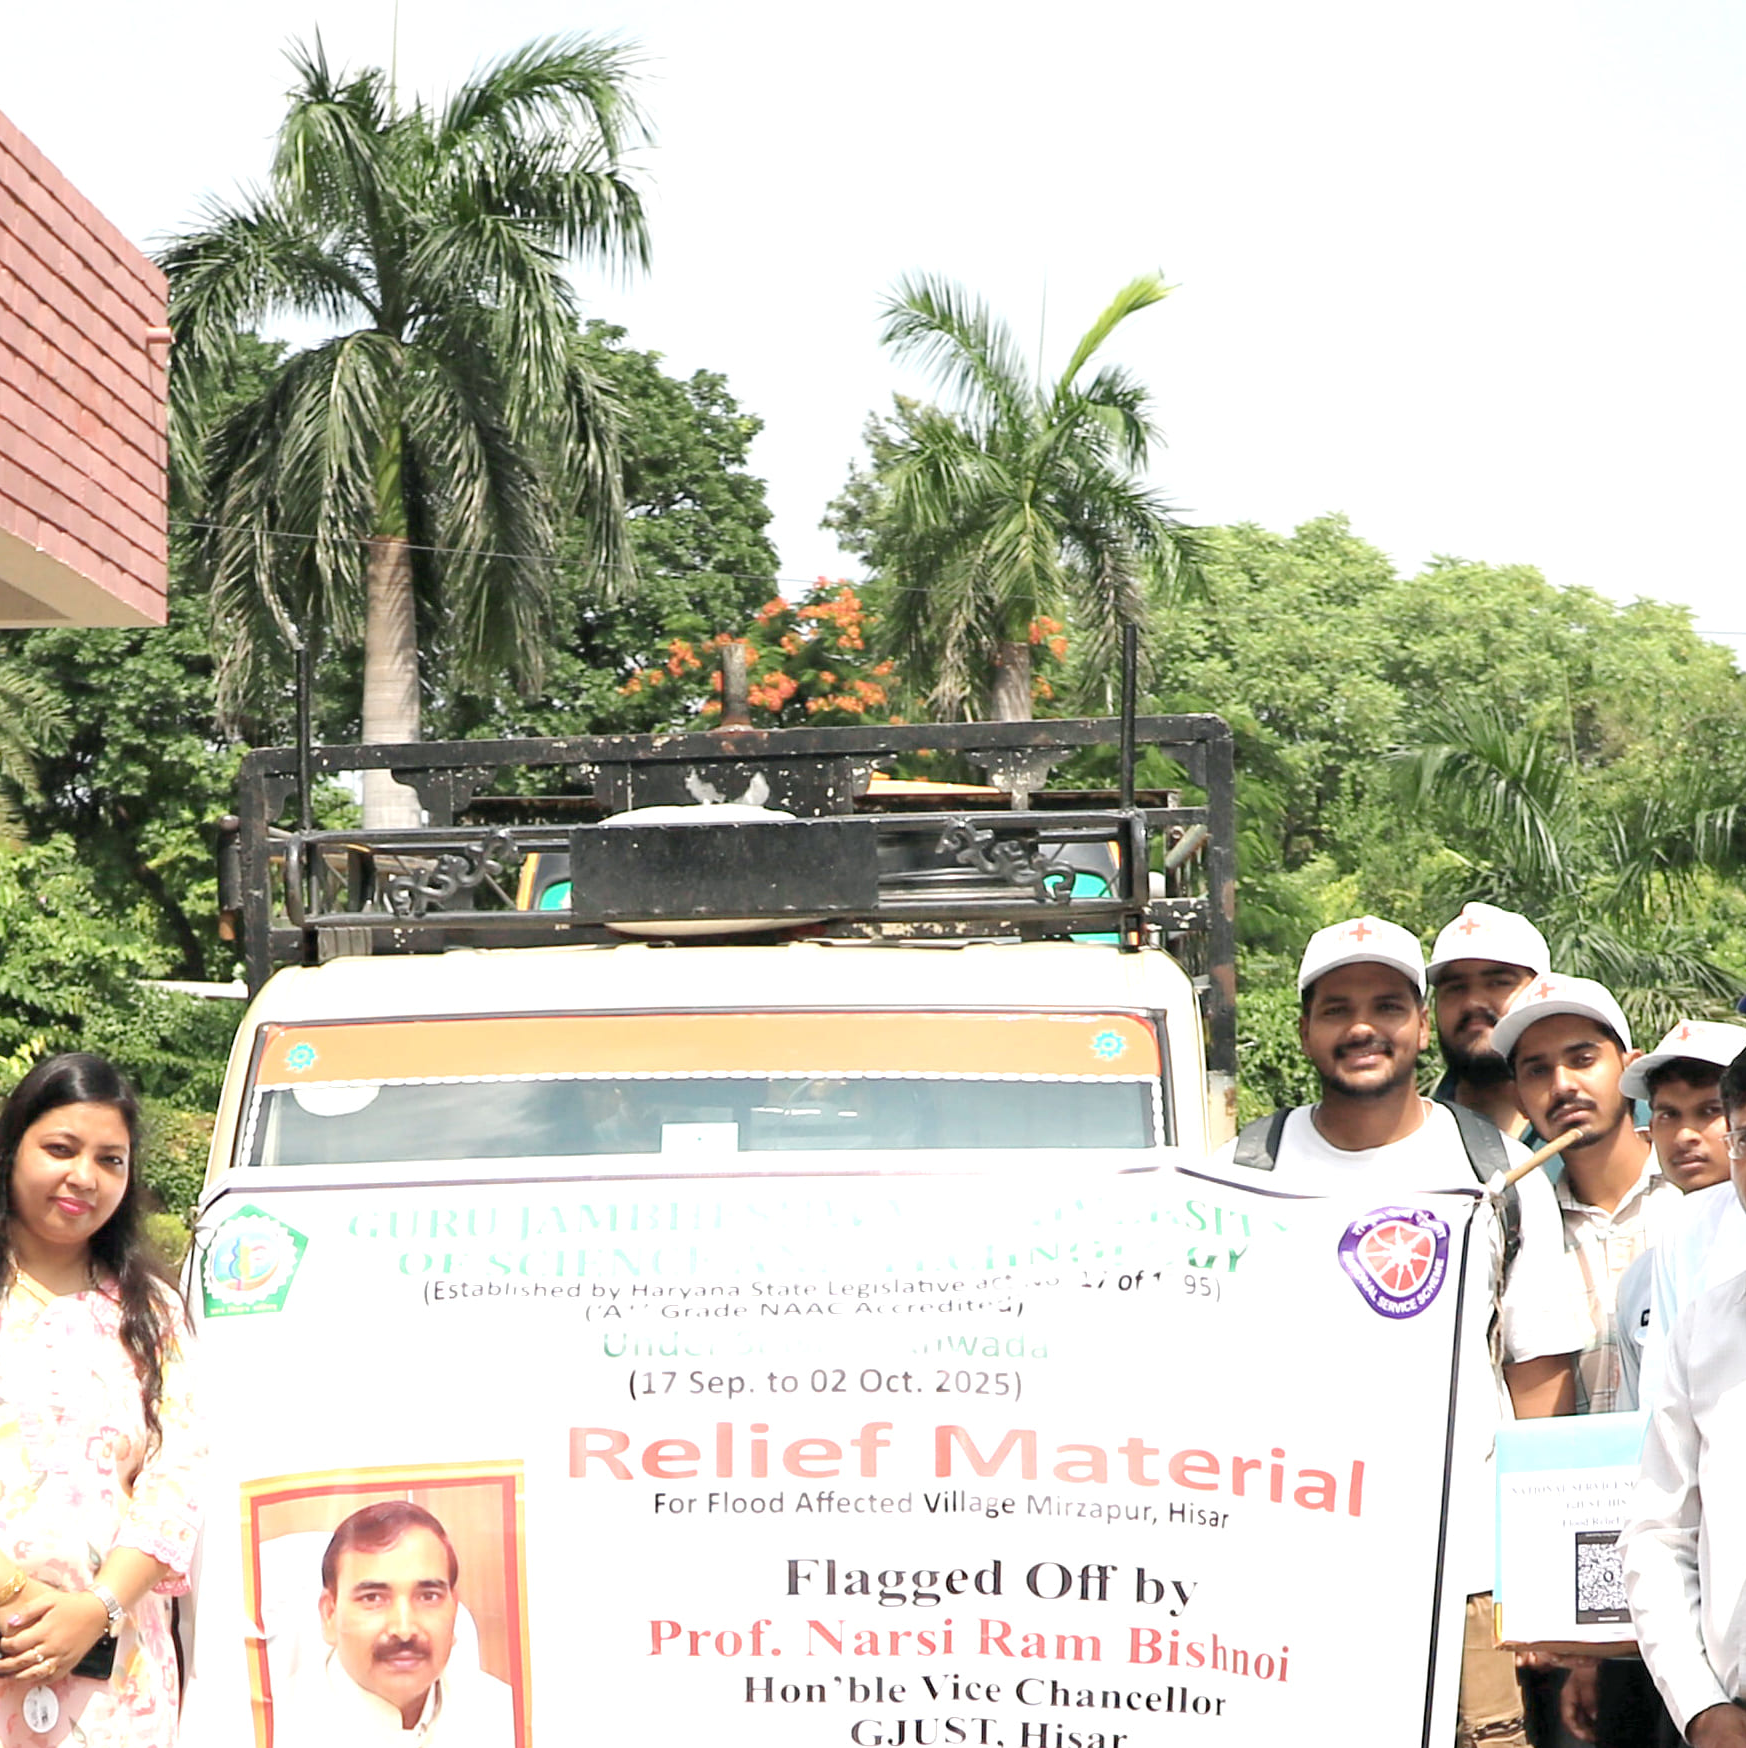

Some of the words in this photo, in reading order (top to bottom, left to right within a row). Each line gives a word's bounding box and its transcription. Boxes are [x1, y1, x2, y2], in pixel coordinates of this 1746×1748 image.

[423, 1280, 581, 1306] (Established
[591, 1282, 621, 1300] by
[631, 1281, 741, 1300] Haryana
[751, 1281, 817, 1298] State
[828, 1275, 964, 1298] Legislative
[1117, 1264, 1145, 1292] of
[661, 1301, 748, 1319] Grade
[760, 1301, 845, 1318] NAAC
[628, 1368, 677, 1402] (17
[689, 1370, 755, 1400] Sep.
[766, 1371, 799, 1393] to
[810, 1368, 847, 1393] 02
[859, 1368, 923, 1394] Oct.
[935, 1369, 1022, 1403] 2025)
[568, 1421, 894, 1481] Relief
[934, 1424, 1366, 1518] Material
[654, 1492, 698, 1515] For
[708, 1490, 784, 1514] Flood
[794, 1490, 912, 1514] Affected
[922, 1489, 1016, 1520] Village
[1027, 1494, 1158, 1526] Mirzapur,
[1168, 1502, 1230, 1529] Hisar
[785, 1558, 1004, 1608] Flagged
[1025, 1561, 1119, 1602] Off
[1135, 1566, 1199, 1618] by
[647, 1618, 782, 1658] Prof.
[806, 1617, 954, 1657] Narsi
[978, 1617, 1102, 1662] Ram
[1127, 1625, 1290, 1683] Bishnoi
[920, 1673, 1002, 1703] Vice
[1015, 1677, 1227, 1718] Chancellor
